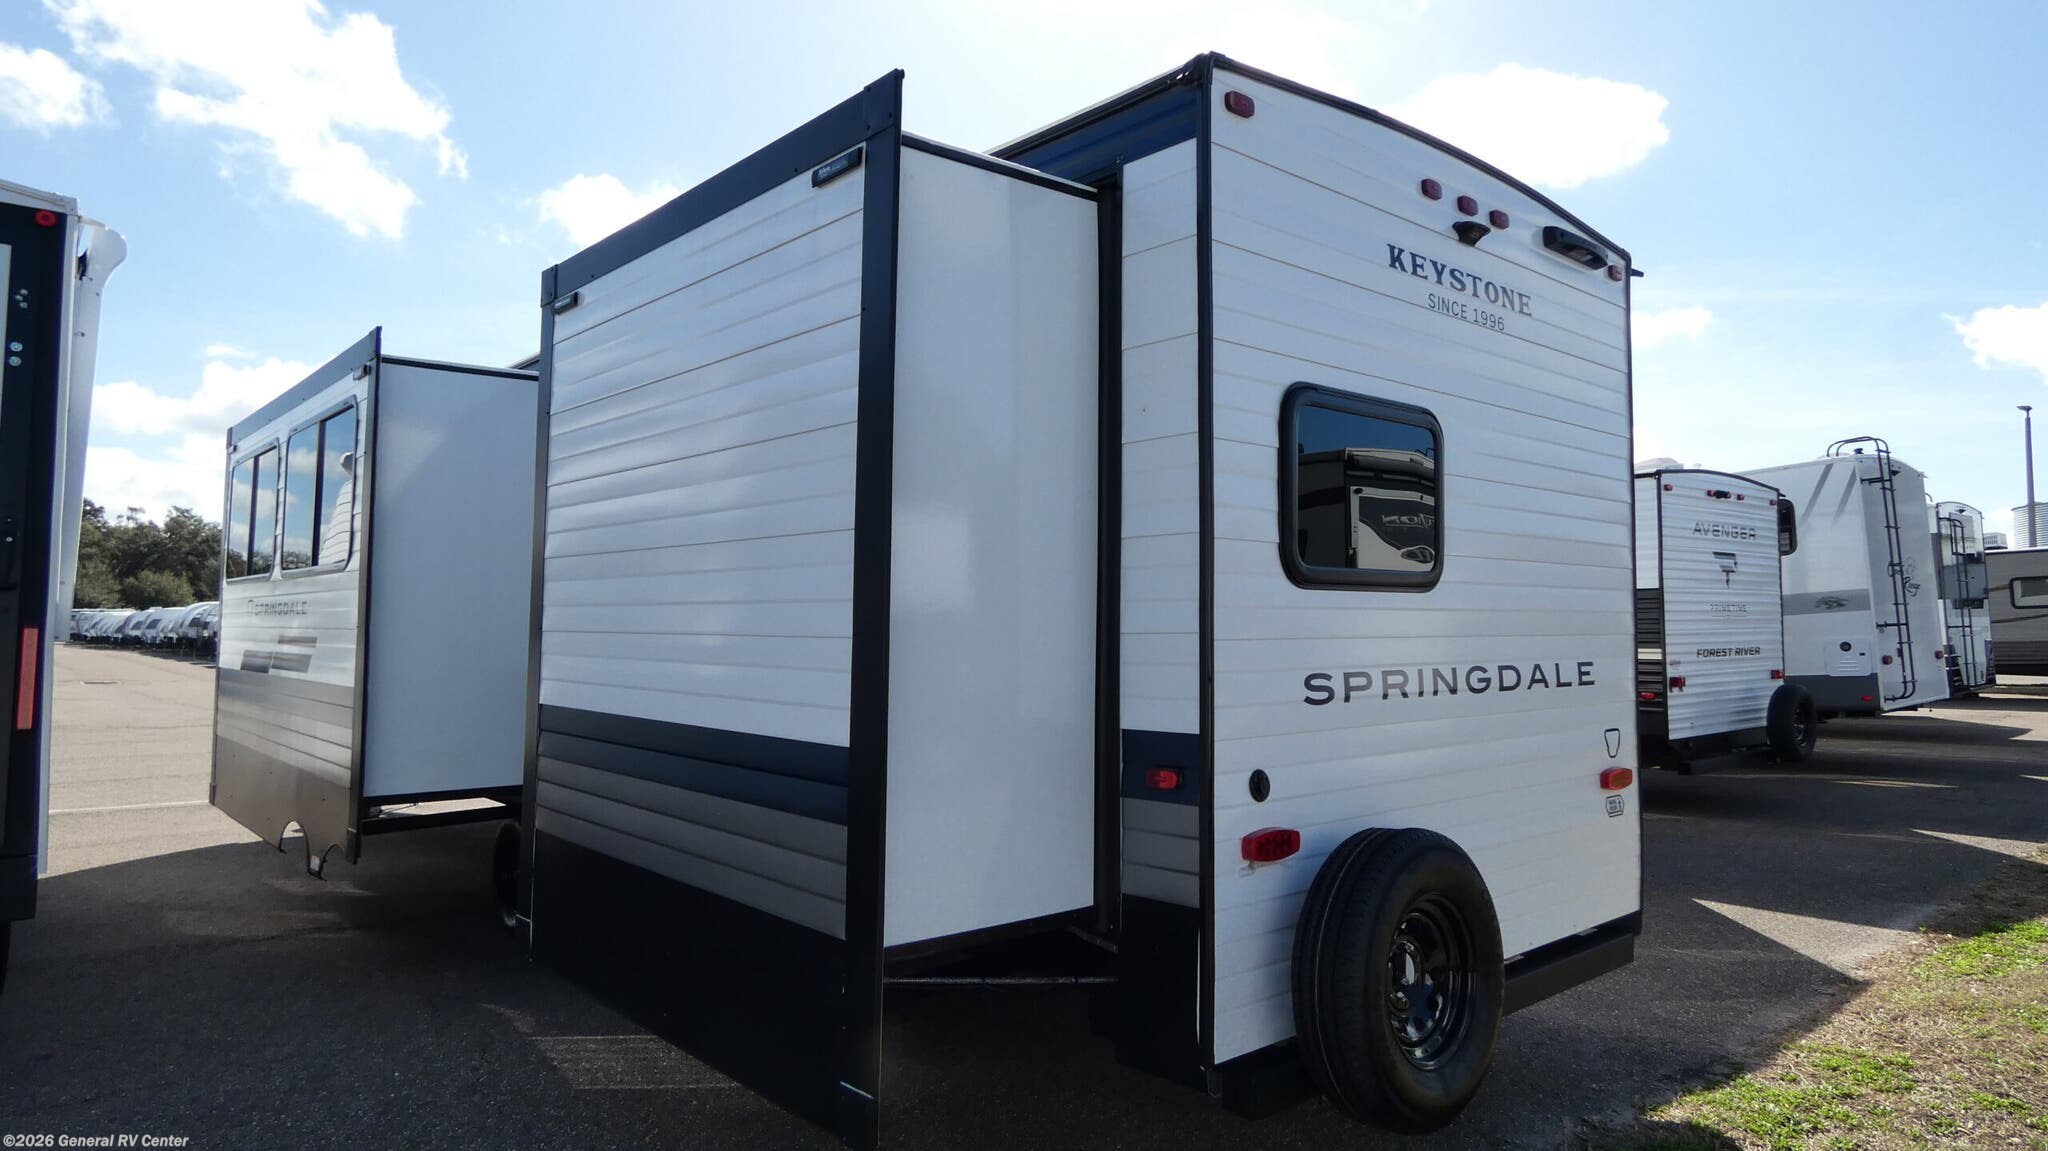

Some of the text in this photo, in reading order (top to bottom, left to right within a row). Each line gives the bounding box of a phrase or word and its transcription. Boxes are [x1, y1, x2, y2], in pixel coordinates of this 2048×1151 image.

[1387, 243, 1533, 317] KEYSTONE
[1428, 293, 1505, 331] SINCE 1996
[1693, 521, 1757, 540] AVENGER
[1696, 646, 1761, 658] FOREST RIVER
[1303, 661, 1596, 706] SPRINGDALE
